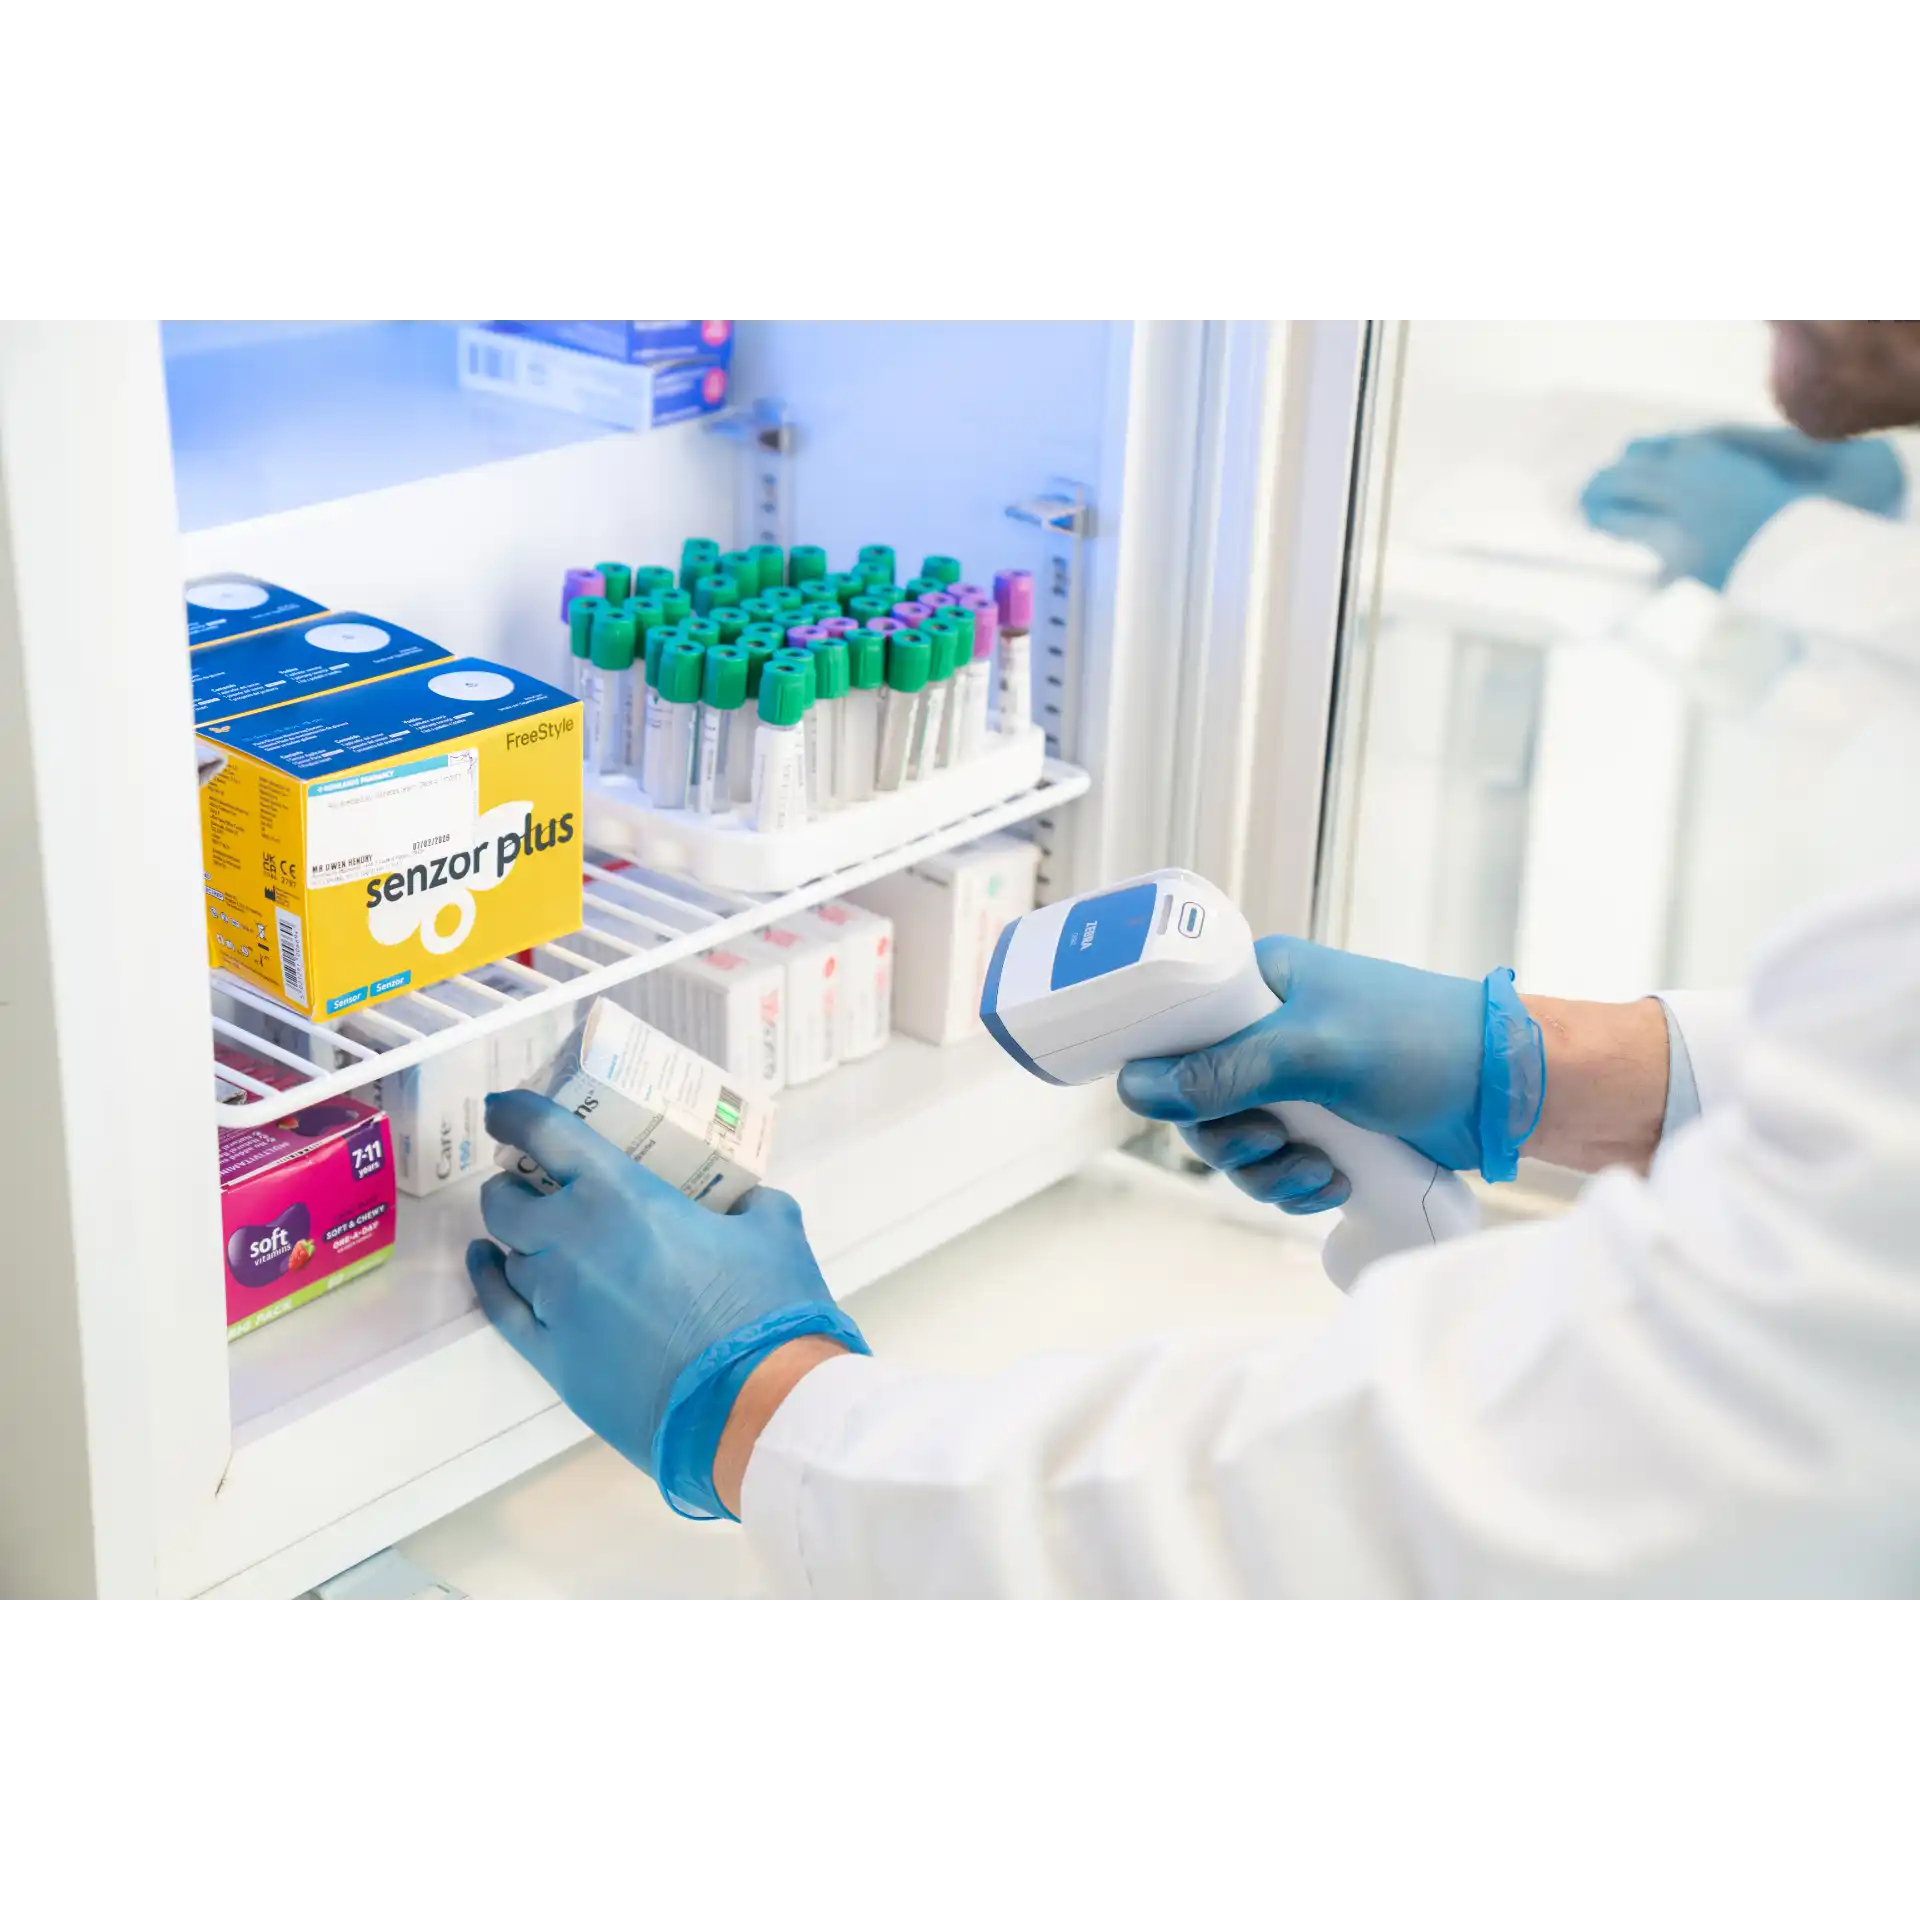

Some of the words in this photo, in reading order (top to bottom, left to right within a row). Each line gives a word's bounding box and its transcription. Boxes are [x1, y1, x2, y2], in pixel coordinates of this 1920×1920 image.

[506, 718, 574, 751] FreeStyle
[325, 861, 346, 872] OWEN
[366, 841, 489, 909] senzor
[497, 812, 574, 878] plus
[1080, 920, 1098, 951] ZEBRA
[376, 977, 405, 993] Senzor
[334, 993, 362, 1010] Sensor
[352, 1139, 383, 1170] 7-11
[358, 1160, 381, 1179] years
[326, 1223, 348, 1240] SOFT
[348, 1220, 356, 1229] &
[356, 1204, 385, 1224] CHEWY
[333, 1220, 381, 1250] ONE-A-DAY
[250, 1226, 289, 1259] soft
[254, 1244, 291, 1267] vitamins
